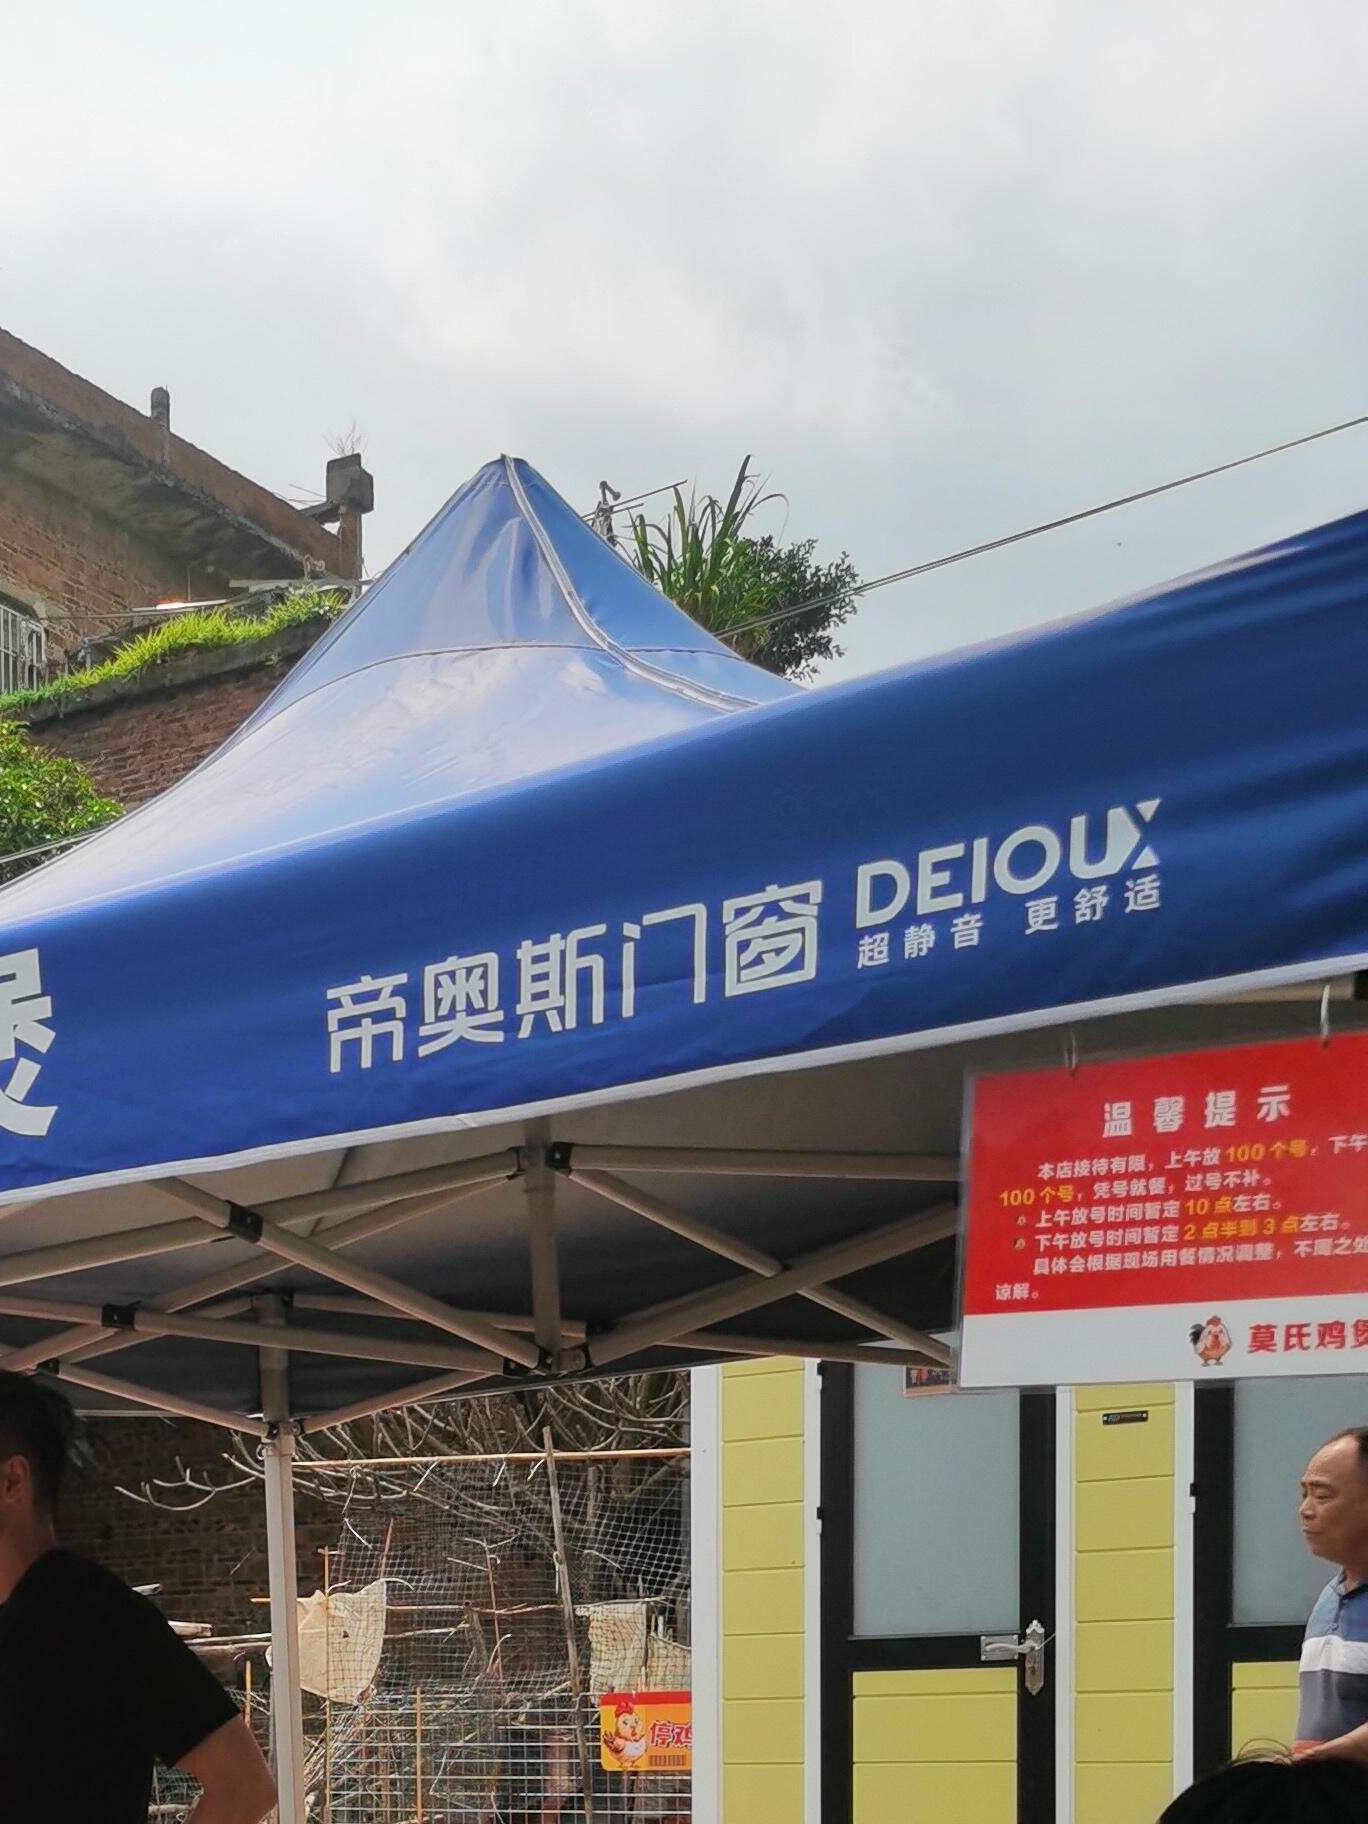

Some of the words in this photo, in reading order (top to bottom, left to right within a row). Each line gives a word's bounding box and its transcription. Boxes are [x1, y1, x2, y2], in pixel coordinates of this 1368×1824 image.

[857, 798, 1163, 929] DEIOUX
[326, 880, 823, 1074] 帝奥斯门窗
[857, 913, 985, 970] 超静音
[1025, 875, 1163, 936] 更舒适
[1102, 1085, 1291, 1138] 温馨提示
